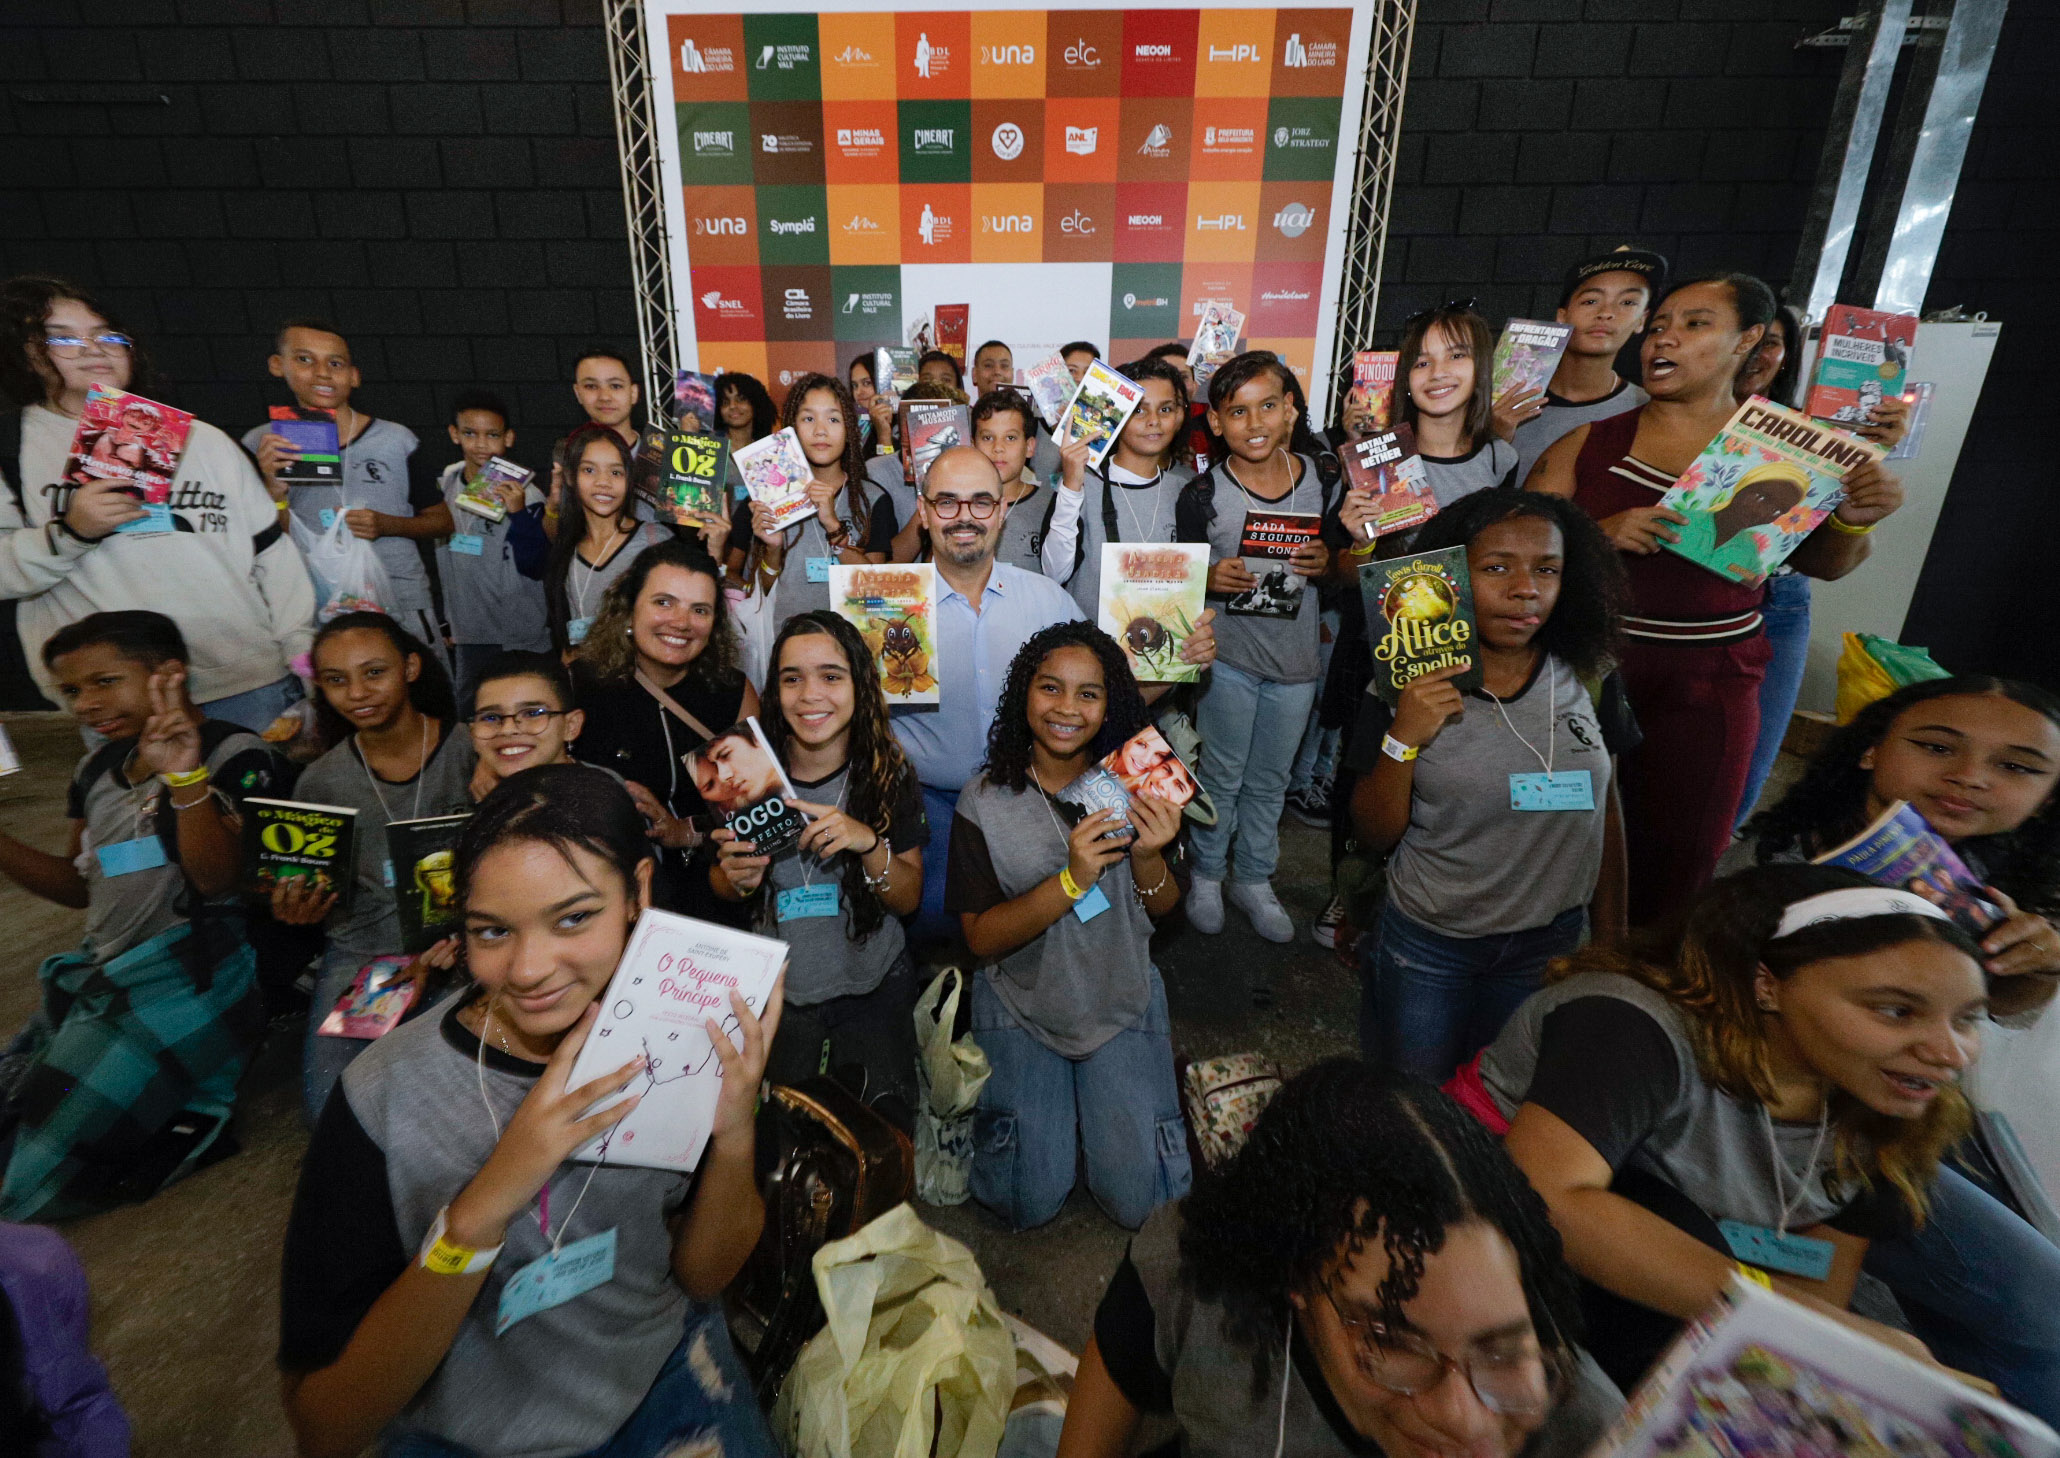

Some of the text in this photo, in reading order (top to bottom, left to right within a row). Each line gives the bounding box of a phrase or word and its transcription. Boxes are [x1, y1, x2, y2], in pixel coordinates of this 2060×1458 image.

[776, 45, 809, 53] INSTITUTO
[1064, 38, 1102, 66] etc.
[1136, 45, 1171, 56] NEOOH
[1309, 42, 1336, 50] CÂMARA
[777, 53, 809, 62] CULTURAL
[992, 45, 1034, 64] una
[777, 61, 794, 69] VALE
[1307, 58, 1336, 66] DO LIVRO
[852, 129, 880, 137] MINAS
[914, 129, 954, 149] CINEART
[1067, 132, 1087, 142] ANL
[1218, 128, 1254, 137] PREFEITURA
[693, 131, 734, 151] CINEART
[853, 137, 885, 145] GERAIS
[1290, 139, 1330, 147] STRATEGY
[705, 217, 747, 235] una
[992, 215, 1033, 232] una
[1060, 208, 1096, 234] etc.
[1128, 215, 1162, 225] NEOOH
[719, 300, 744, 309] SNEL
[1509, 323, 1570, 337] ENFRENTANDO
[1517, 333, 1560, 347] DRAGÃO
[1833, 338, 1882, 354] MULHERES
[918, 409, 958, 421] MIYAMOTO
[921, 417, 955, 426] MUSASHI
[680, 434, 722, 449] Mágico
[1355, 431, 1397, 453] BATALHA
[1739, 404, 1874, 468] CAROLINA
[1360, 446, 1402, 469] NETHER
[1368, 444, 1389, 457] PELO
[672, 446, 718, 478] Oz
[1252, 521, 1286, 532] CADA
[1250, 532, 1310, 543] SEGUNDO
[1385, 559, 1444, 581] Lewis Carroll
[1374, 606, 1471, 661] Alice
[1390, 653, 1472, 690] Espelho
[273, 809, 344, 828] Mágico
[261, 823, 338, 858] Oz
[270, 854, 299, 863] Frank
[300, 857, 331, 867] Baum
[694, 943, 729, 956] ANTOINE DE
[657, 952, 741, 991] O Pequeno
[658, 977, 722, 1016] Príncipe
